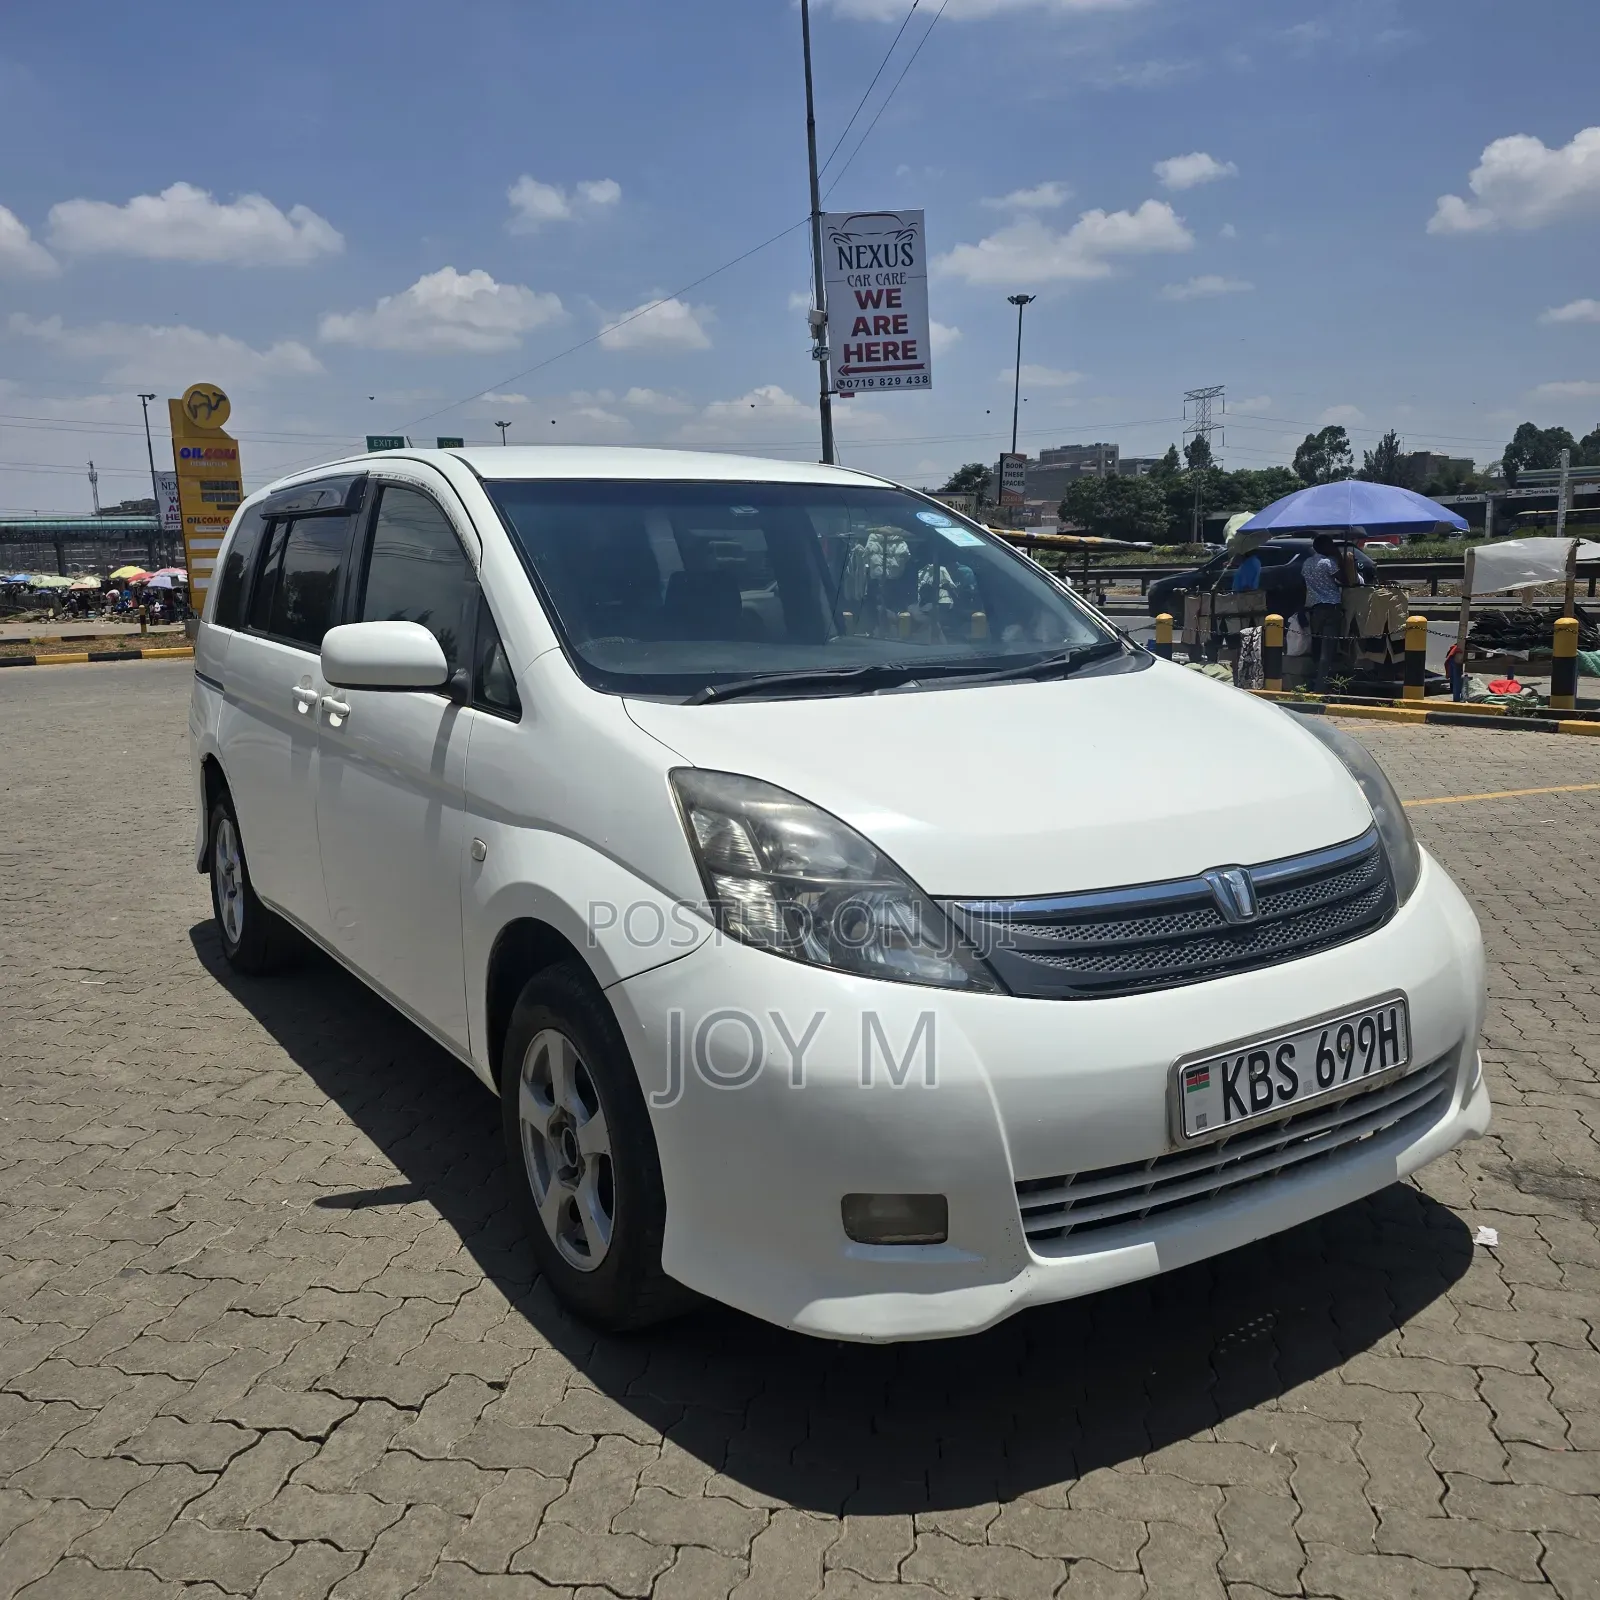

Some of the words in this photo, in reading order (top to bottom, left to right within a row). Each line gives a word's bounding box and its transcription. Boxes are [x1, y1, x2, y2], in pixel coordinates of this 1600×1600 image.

[837, 242, 914, 270] NEXUS
[847, 273, 872, 288] CAR
[875, 272, 907, 287] CARE
[854, 288, 902, 310] WE
[851, 314, 909, 337] ARE
[843, 340, 918, 364] HERE
[846, 378, 875, 388] 0719
[879, 377, 902, 387] 829
[906, 375, 929, 385] 438
[373, 439, 393, 447] EXIT
[393, 439, 399, 447] 5
[180, 447, 237, 460] OILCOM
[187, 516, 221, 525] OILCOM
[1221, 1042, 1299, 1122] KBS
[1316, 1007, 1400, 1089] 699H
